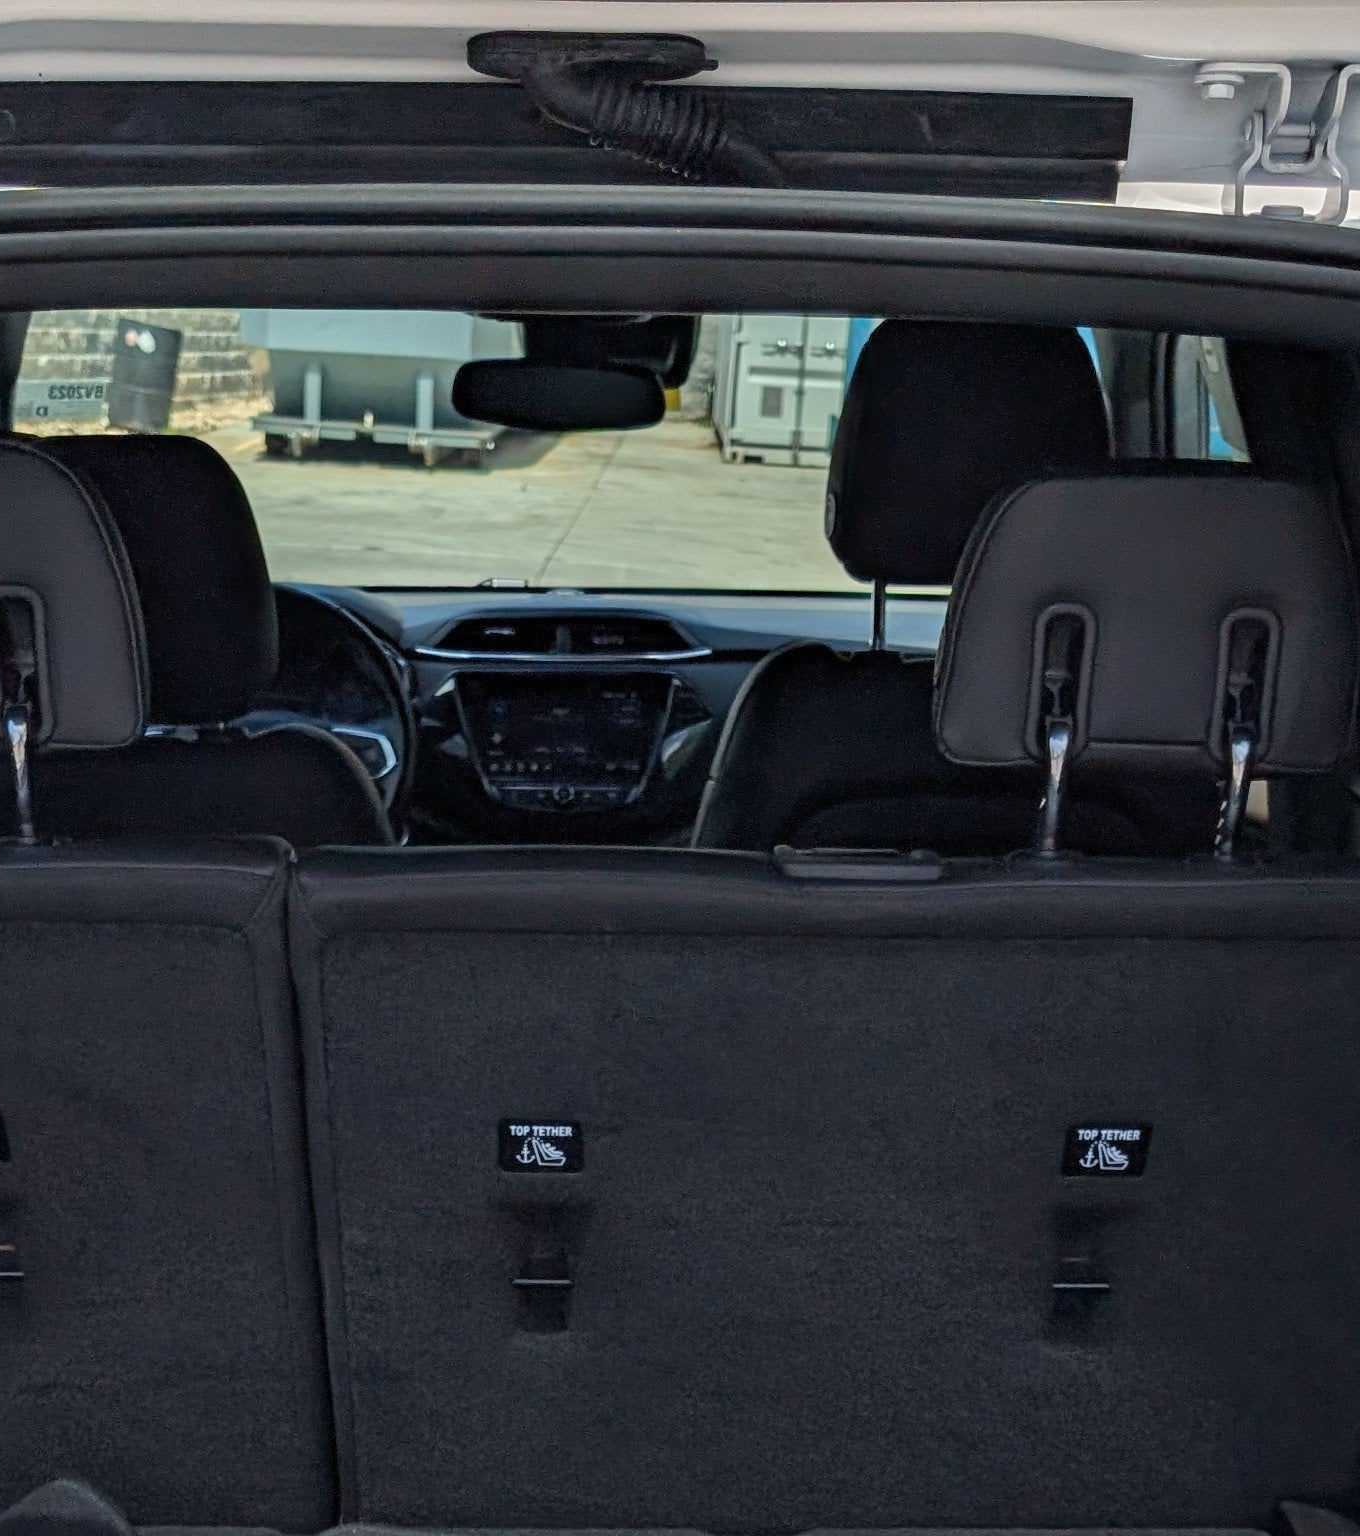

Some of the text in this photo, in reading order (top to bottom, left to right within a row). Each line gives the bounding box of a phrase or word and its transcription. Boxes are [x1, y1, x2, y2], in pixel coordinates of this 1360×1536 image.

[509, 1125, 573, 1137] TOP TETHER
[1077, 1129, 1140, 1141] TOP TETHER
